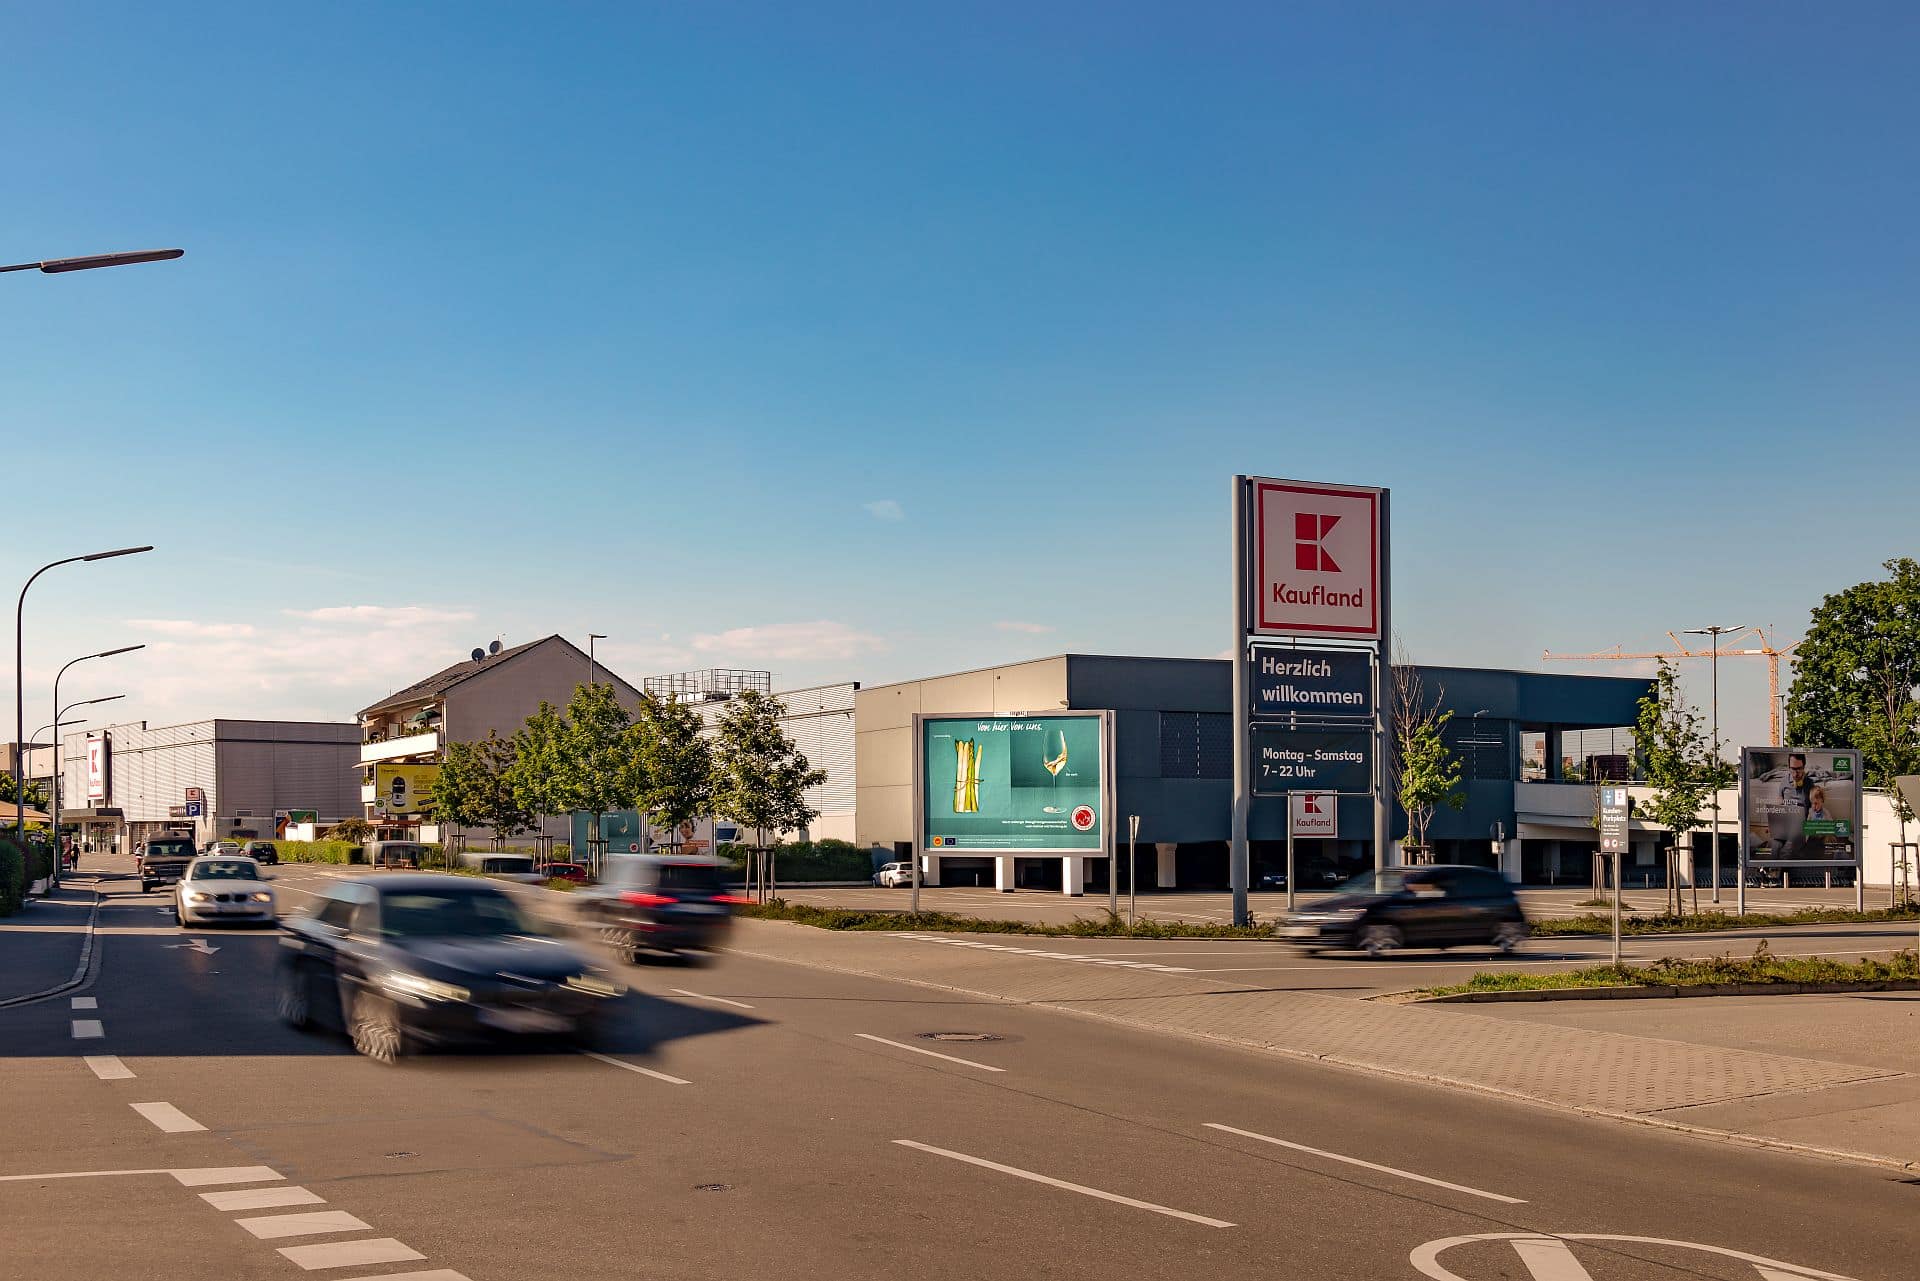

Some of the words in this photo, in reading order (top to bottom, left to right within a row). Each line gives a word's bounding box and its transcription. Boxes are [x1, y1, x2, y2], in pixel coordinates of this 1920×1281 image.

[1272, 583, 1363, 607] Kaufland
[1262, 656, 1332, 677] Herzlich
[1261, 685, 1364, 705] willkommen
[977, 721, 991, 731] Von
[992, 721, 1009, 731] hier.
[1010, 721, 1025, 731] Von
[1025, 722, 1043, 731] uns.
[1263, 747, 1305, 762] Montag
[1314, 749, 1363, 763] Samstag
[1280, 765, 1293, 777] 22
[1296, 766, 1316, 777] Uhr
[1296, 818, 1331, 827] Kaufland
